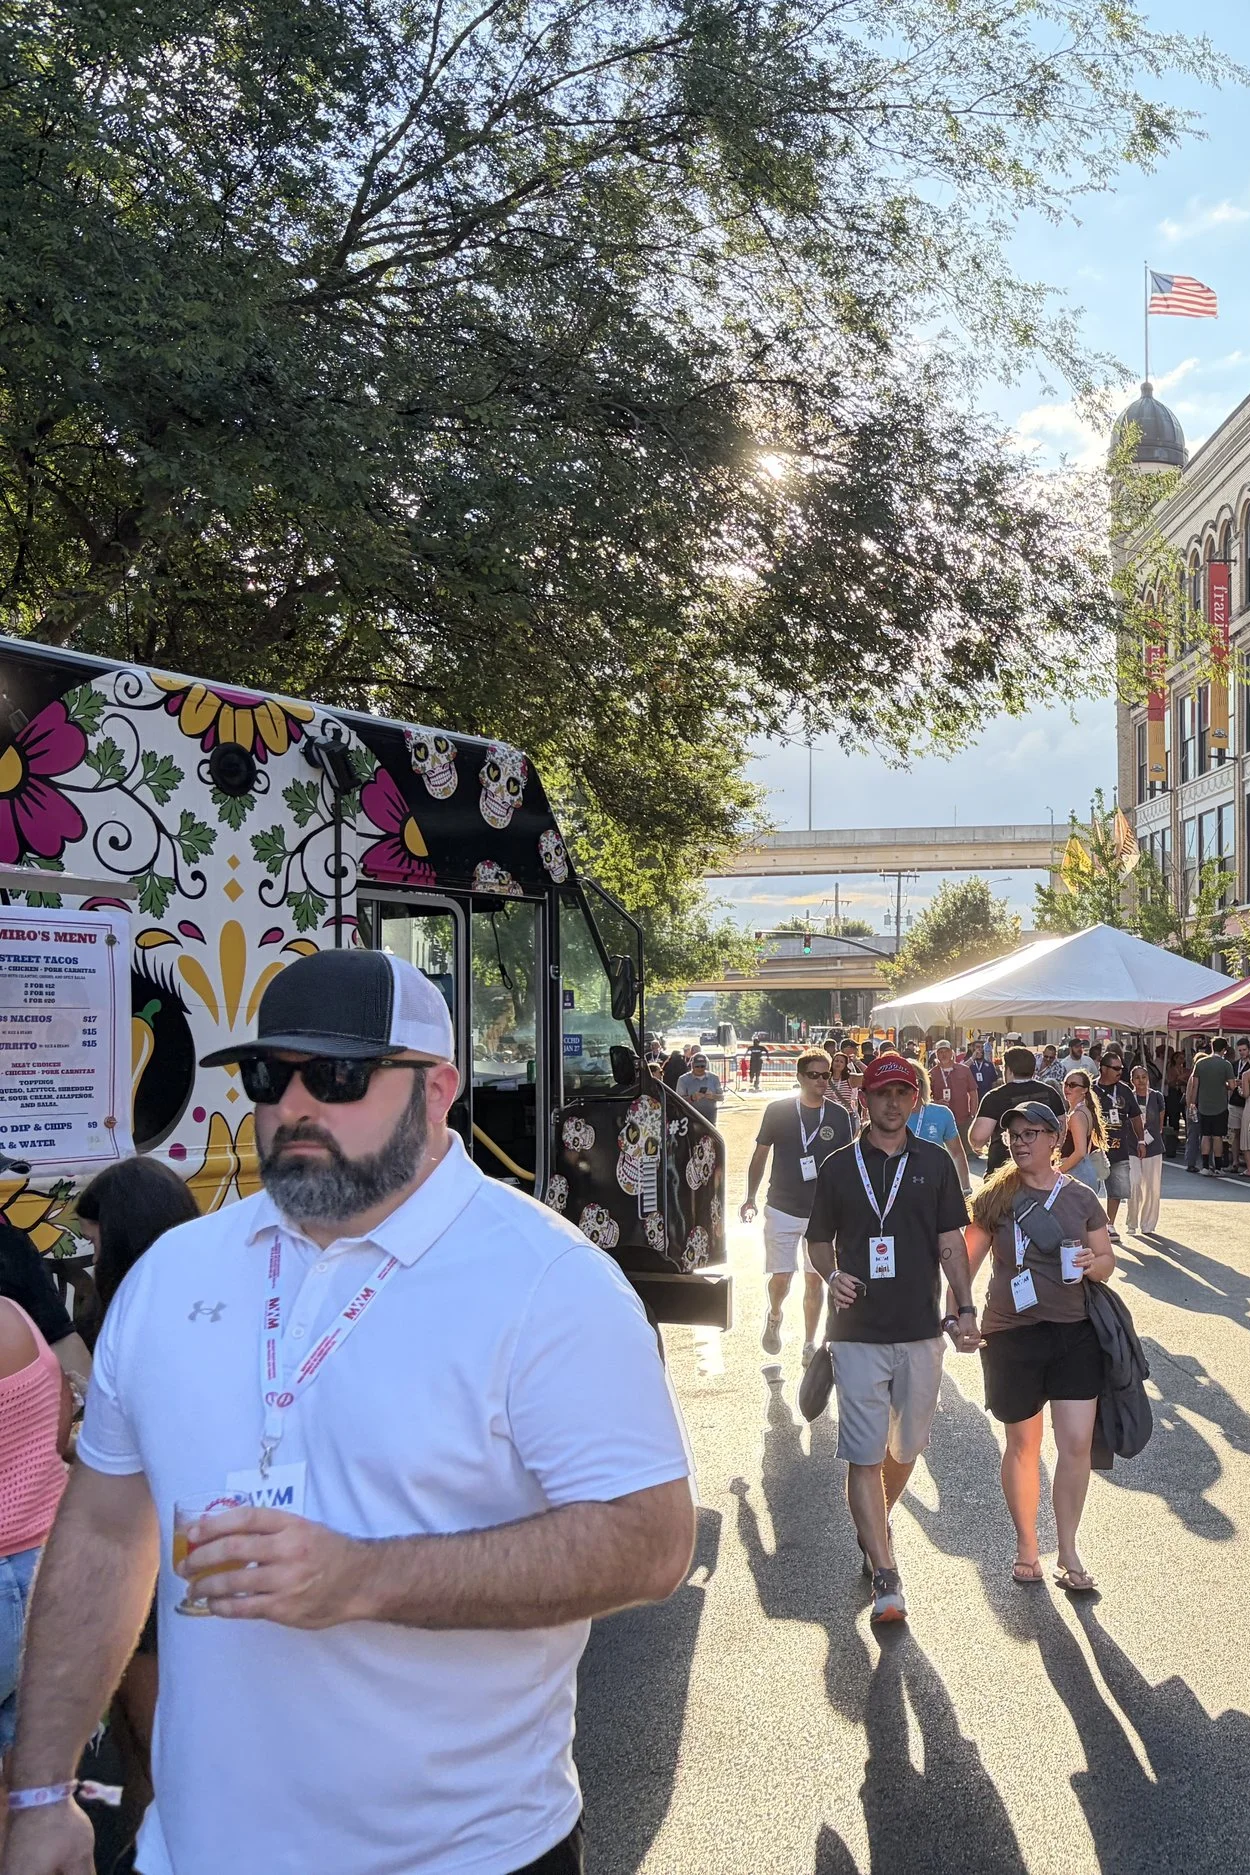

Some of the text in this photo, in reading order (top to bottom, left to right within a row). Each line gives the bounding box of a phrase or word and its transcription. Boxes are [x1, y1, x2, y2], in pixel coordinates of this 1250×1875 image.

[54, 932, 97, 944] MENU
[43, 955, 79, 964] TACOS
[10, 1015, 52, 1023] NACHOS
[10, 1124, 31, 1132] DIP
[34, 1123, 42, 1131] &
[44, 1122, 72, 1130] CHIPS
[669, 1116, 688, 1136] #3
[8, 1141, 17, 1149] &
[19, 1139, 55, 1148] WATER
